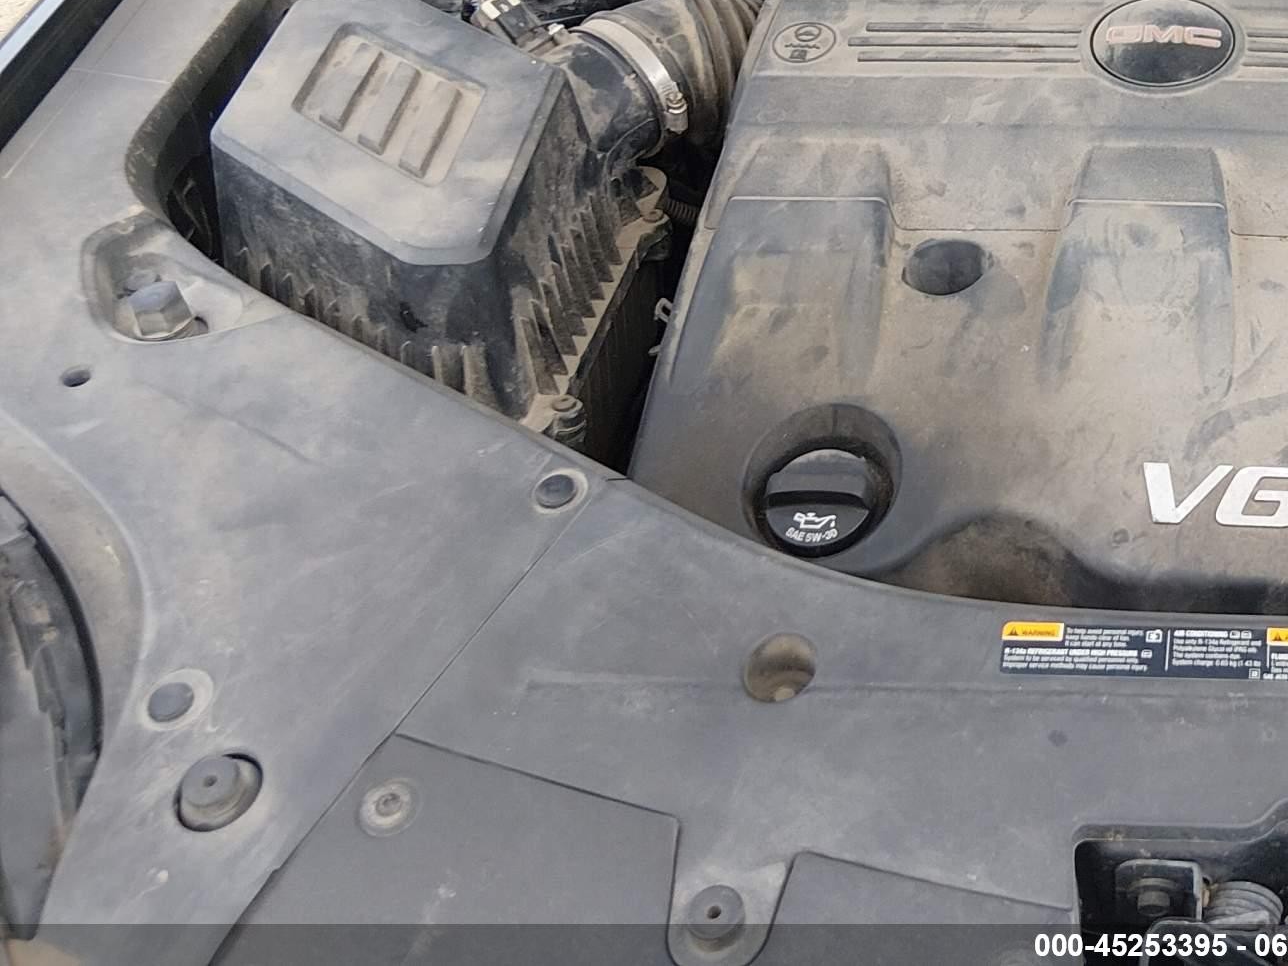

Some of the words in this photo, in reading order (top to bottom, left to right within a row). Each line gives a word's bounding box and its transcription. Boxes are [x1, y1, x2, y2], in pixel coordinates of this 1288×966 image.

[1106, 25, 1222, 48] GMC
[785, 527, 805, 542] SAE
[805, 528, 838, 543] 5W-30
